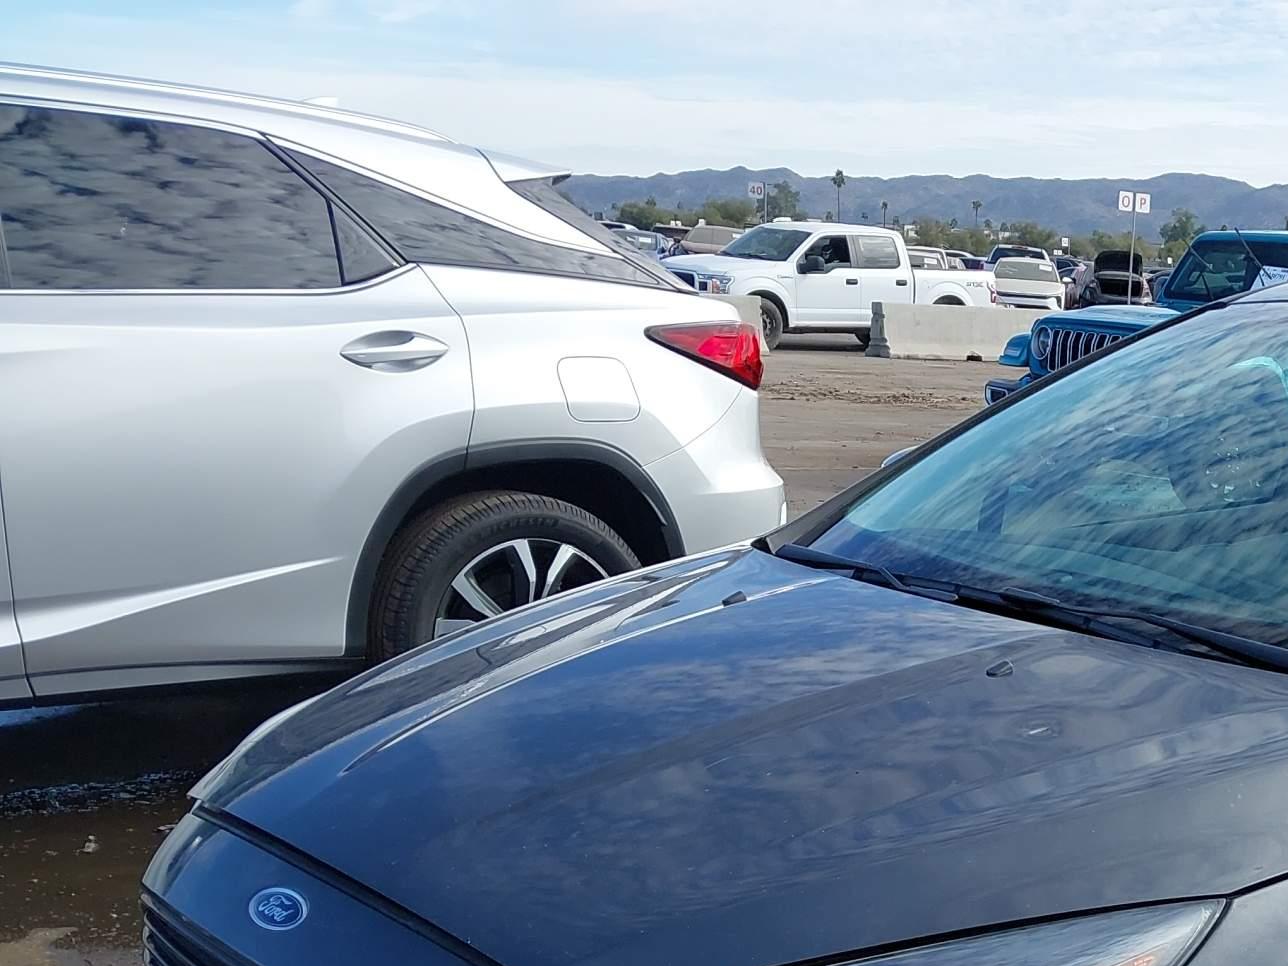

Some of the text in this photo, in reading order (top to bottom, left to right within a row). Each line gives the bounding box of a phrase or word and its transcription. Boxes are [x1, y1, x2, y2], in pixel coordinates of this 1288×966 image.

[749, 186, 762, 195] 40
[1139, 197, 1147, 209] P
[258, 894, 294, 922] Ford
